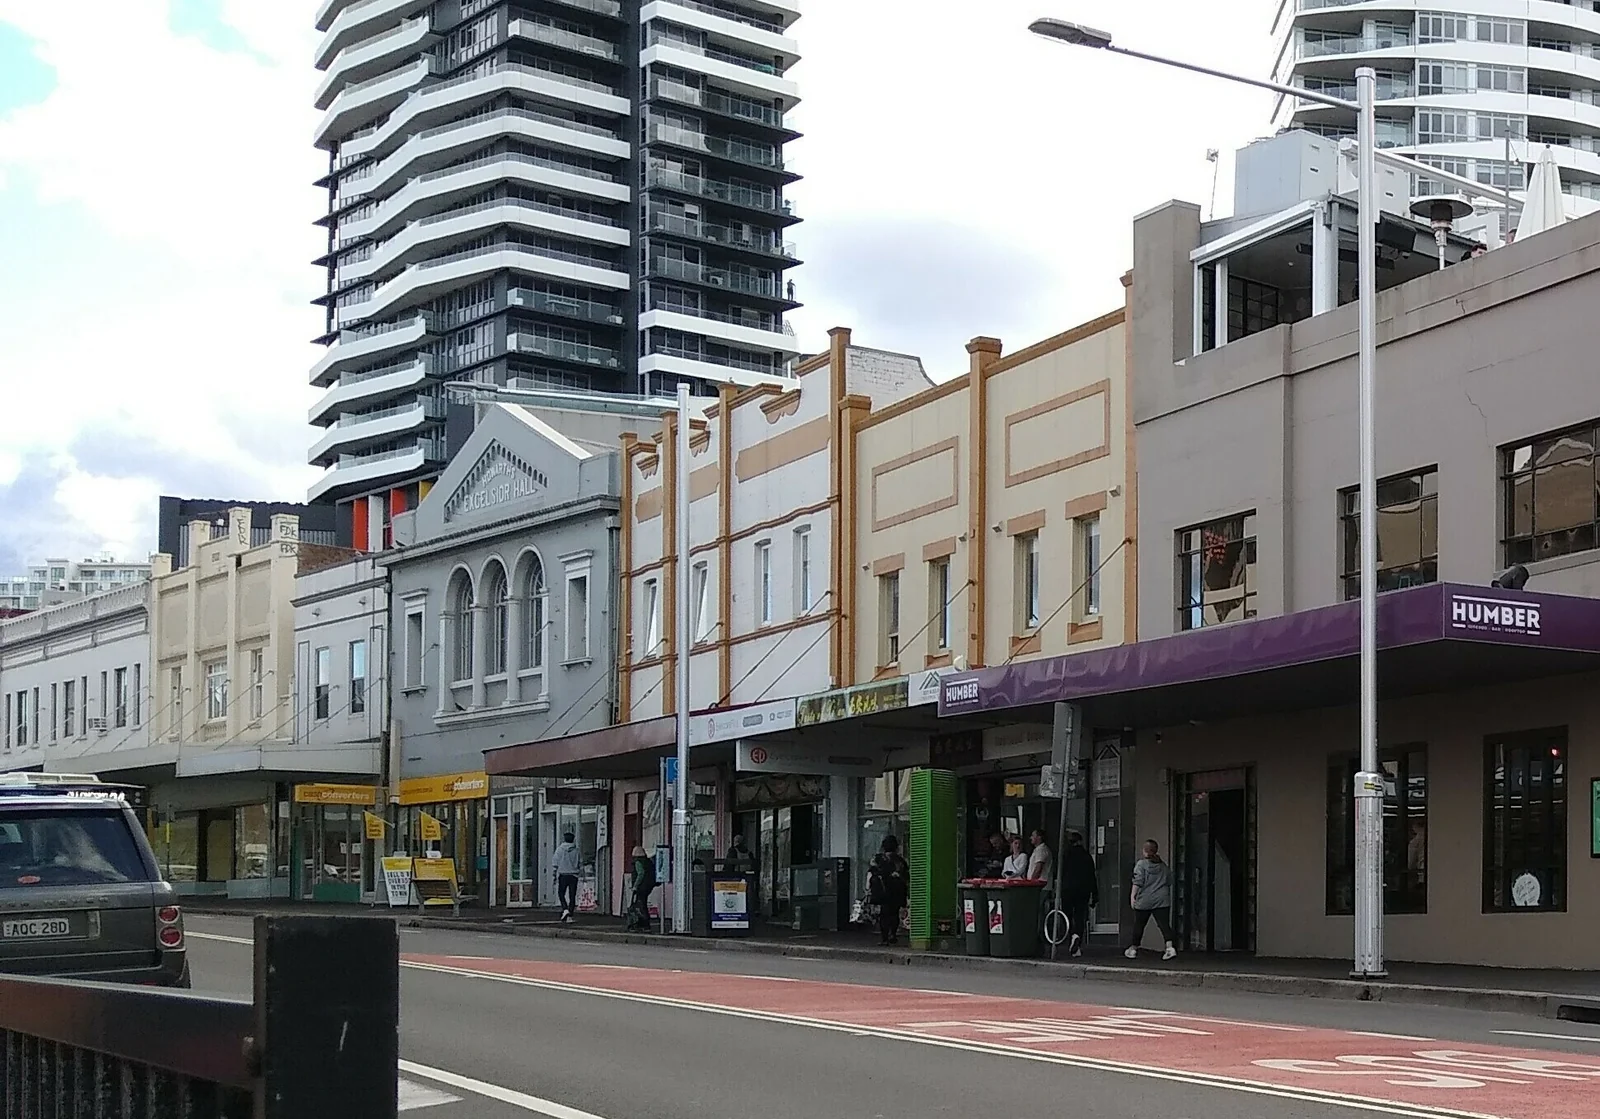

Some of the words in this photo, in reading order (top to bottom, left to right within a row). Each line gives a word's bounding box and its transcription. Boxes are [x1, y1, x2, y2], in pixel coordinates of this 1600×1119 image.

[464, 484, 511, 511] EXCELSIOR
[513, 477, 537, 499] HALL
[1452, 601, 1541, 629] HUMBER
[946, 683, 979, 702] HUMBER
[41, 921, 67, 934] 28D
[1250, 1050, 1600, 1089] BUS
